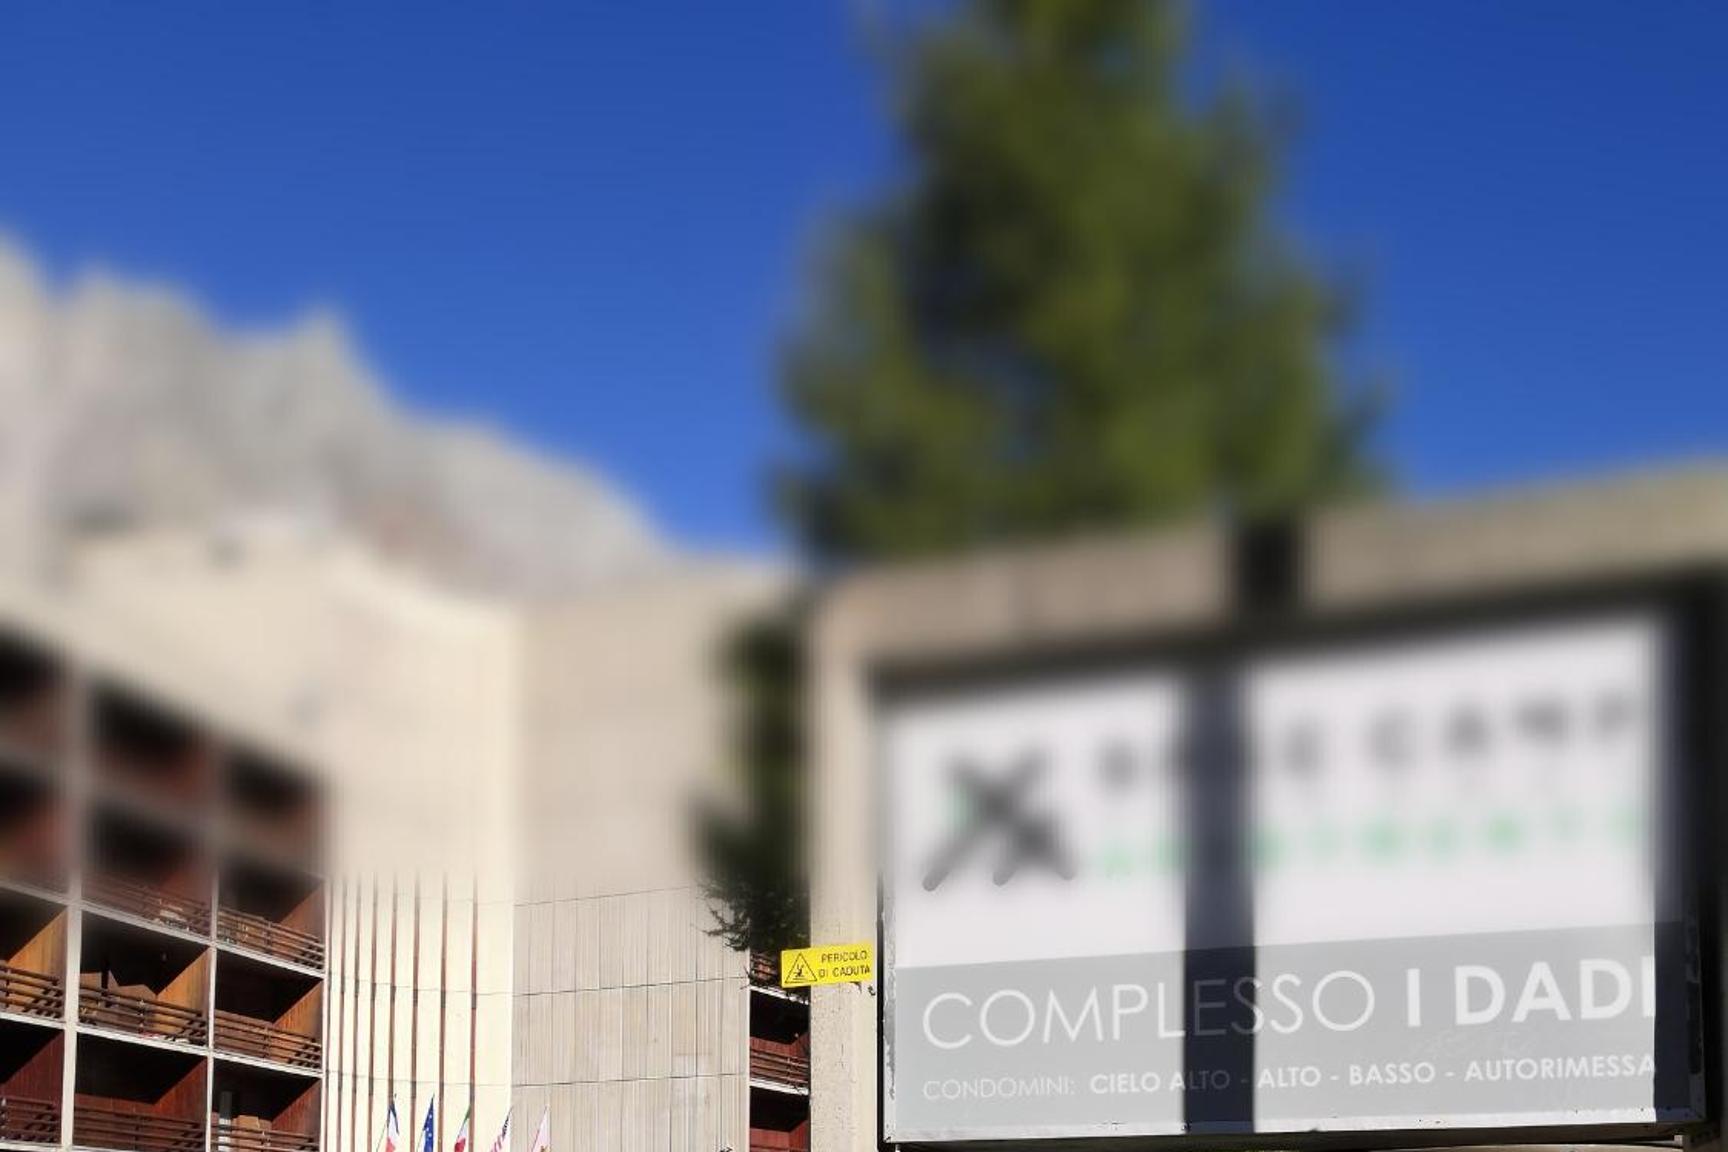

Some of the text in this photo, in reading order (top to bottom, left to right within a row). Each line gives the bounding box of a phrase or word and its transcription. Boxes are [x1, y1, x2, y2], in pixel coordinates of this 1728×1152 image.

[819, 965, 870, 978] DI CADUTA
[821, 950, 867, 963] PERICOLO
[922, 954, 1655, 1050] COMPLESSO I DADI
[922, 1075, 1075, 1101] CONDOMINI:
[1089, 1071, 1161, 1094] CIELO
[1169, 1069, 1231, 1092] ALTO
[1257, 1065, 1322, 1090] ALTO
[1349, 1061, 1436, 1086] BASSO
[1464, 1054, 1655, 1082] AUTORIMESSA
